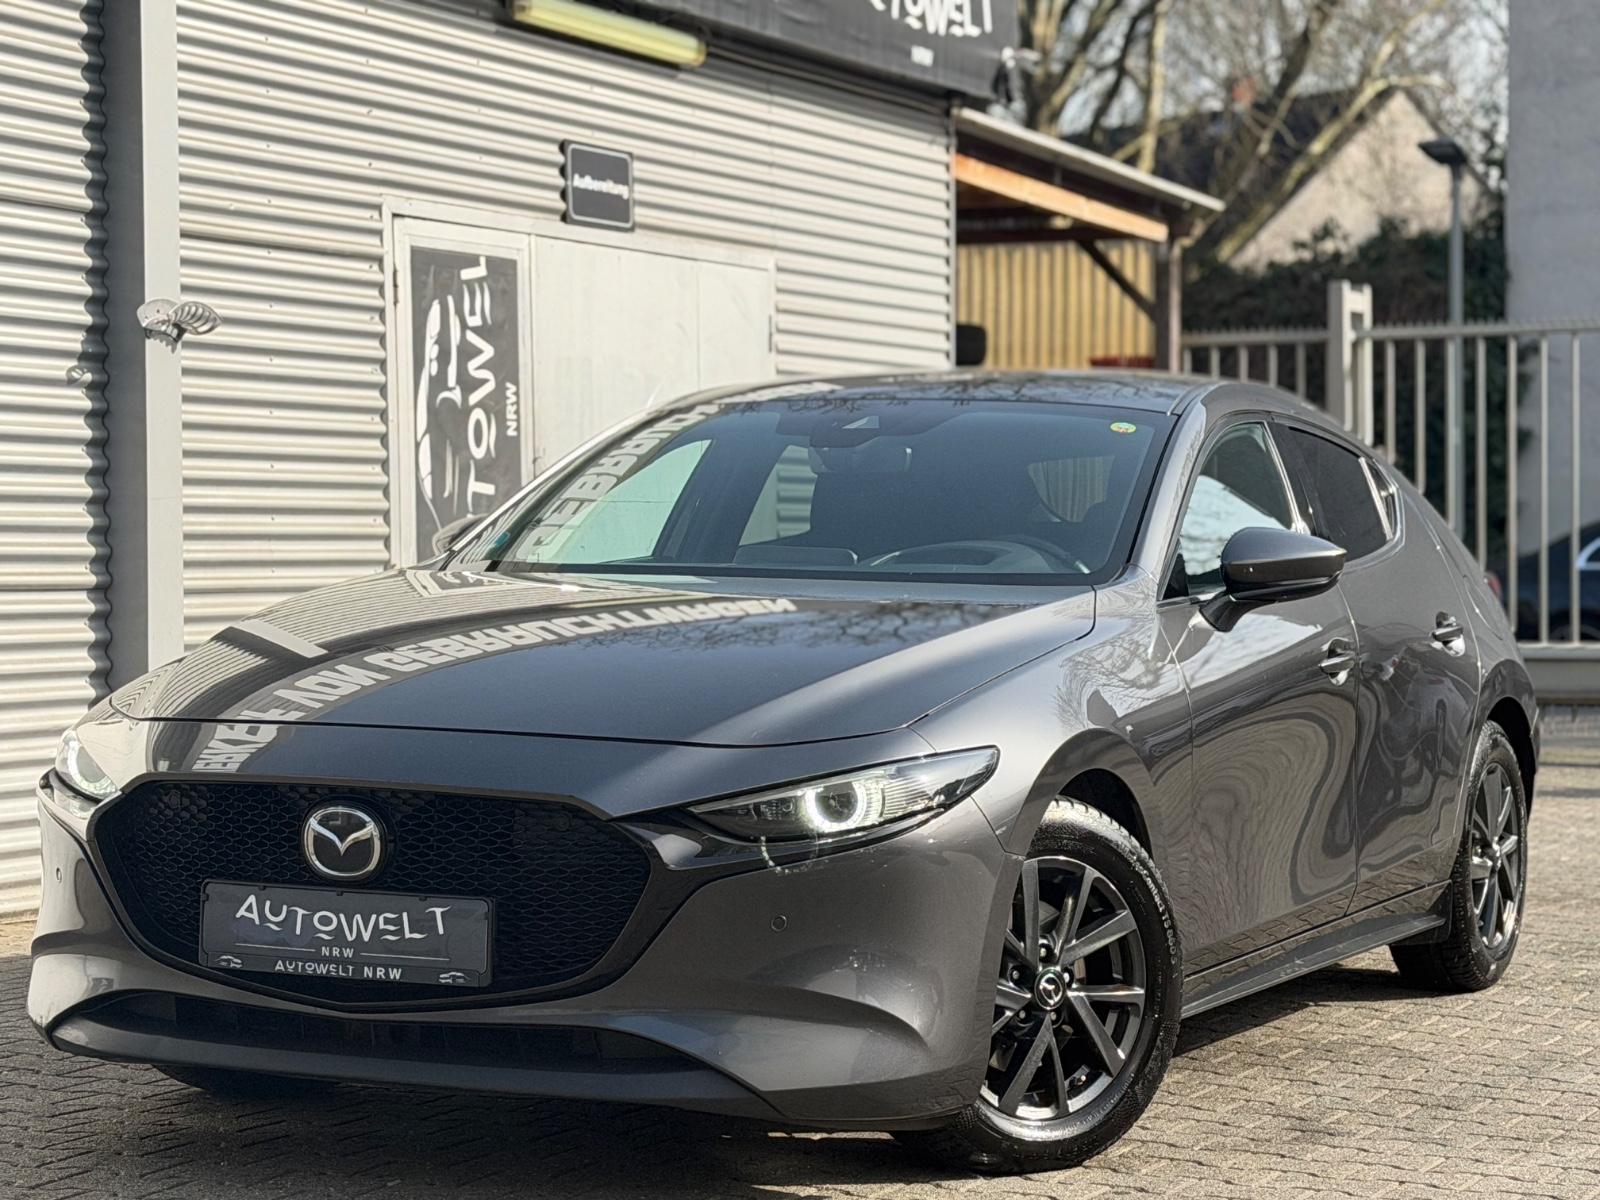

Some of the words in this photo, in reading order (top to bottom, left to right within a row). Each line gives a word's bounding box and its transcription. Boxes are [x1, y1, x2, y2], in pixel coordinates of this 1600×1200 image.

[460, 255, 496, 517] TOWEL
[505, 382, 518, 437] NRW
[235, 894, 452, 942] AUTOWELT
[274, 960, 355, 977] AUTOWELT
[363, 966, 402, 980] NRW
[321, 946, 354, 958] NRW
